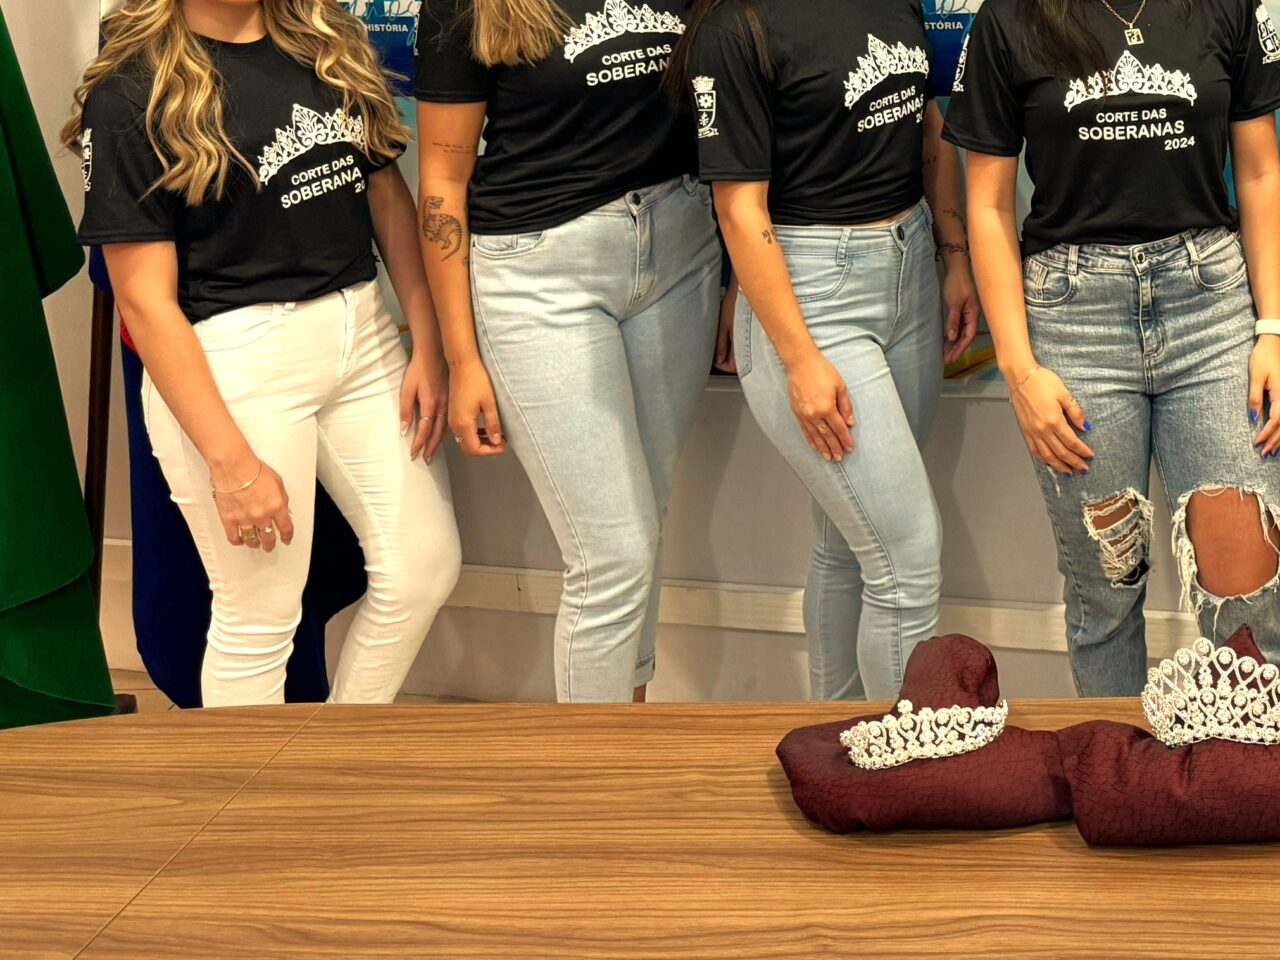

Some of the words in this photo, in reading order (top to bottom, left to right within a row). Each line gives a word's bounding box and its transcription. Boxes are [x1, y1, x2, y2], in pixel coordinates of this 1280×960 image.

[924, 20, 964, 30] STÓRIA
[601, 49, 645, 66] CORTE
[646, 43, 672, 57] DAS
[586, 56, 670, 87] SOBERAN
[869, 93, 899, 112] CORTE
[901, 85, 916, 101] DAS
[857, 95, 924, 133] SOBERANAS
[1096, 111, 1138, 123] CORTE
[1141, 108, 1167, 120] DAS
[1078, 120, 1185, 140] SOBERANAS
[1164, 136, 1195, 150] 2024
[291, 163, 331, 186] CORTE
[332, 154, 355, 172] DAS
[280, 167, 363, 209] SOBERANA
